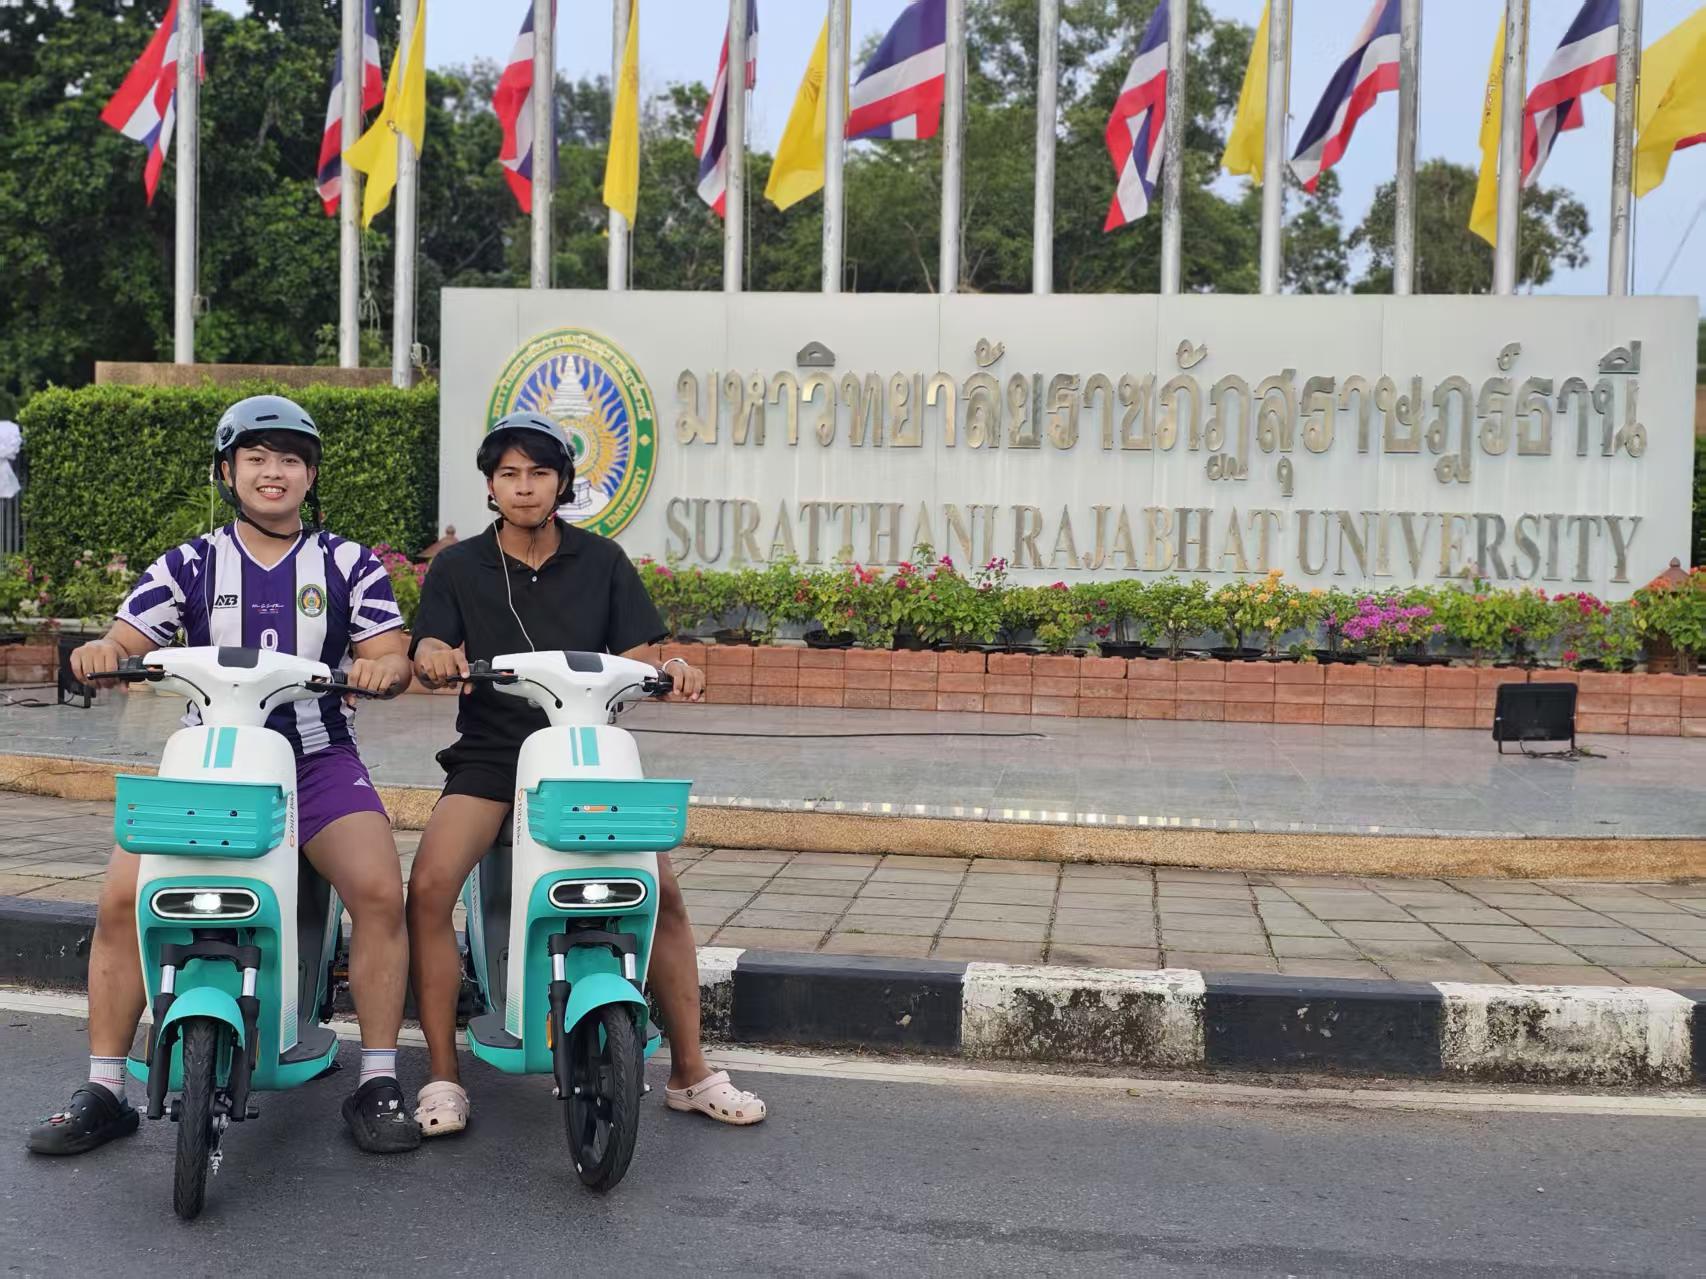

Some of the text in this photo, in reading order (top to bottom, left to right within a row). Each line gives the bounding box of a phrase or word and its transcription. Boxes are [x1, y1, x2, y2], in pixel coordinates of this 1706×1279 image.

[676, 338, 1648, 497] มหาวิทยาลัยราชภัฏสุราษฎร์ธานี
[1011, 505, 1283, 574] RAJABHAT
[1296, 509, 1644, 584] UNIVERSITY
